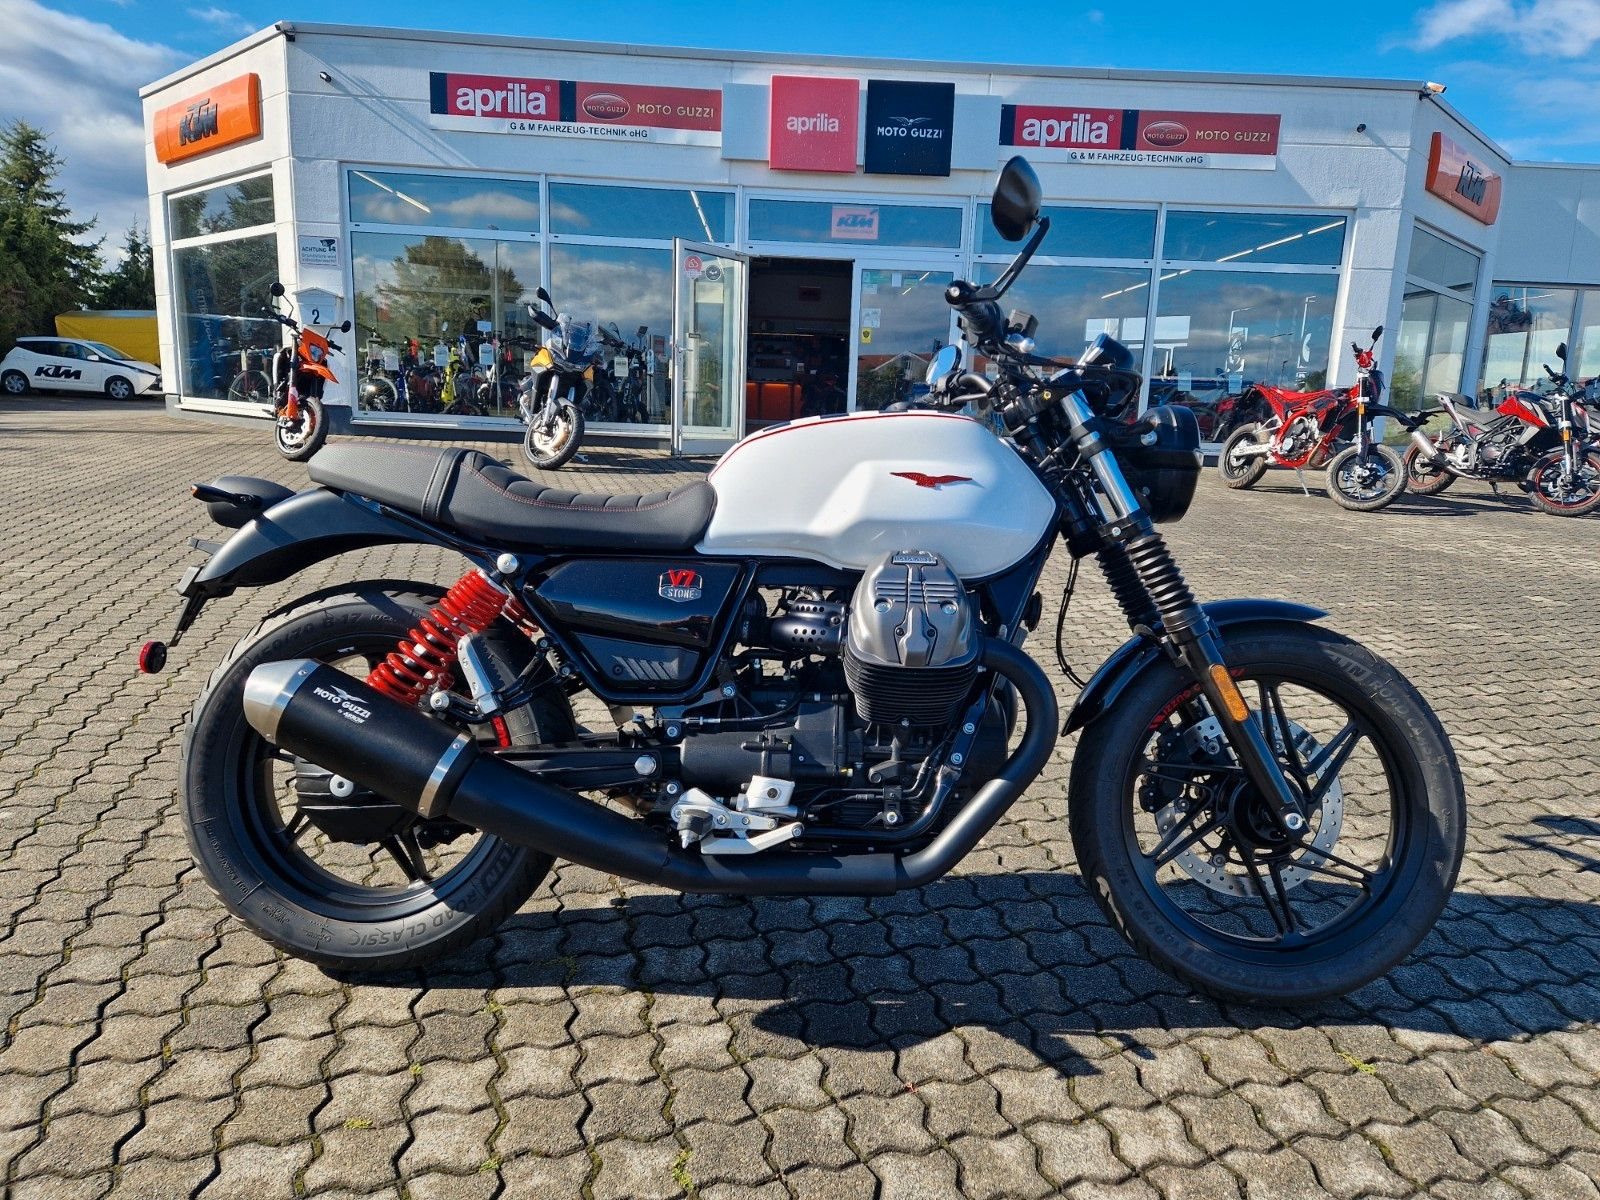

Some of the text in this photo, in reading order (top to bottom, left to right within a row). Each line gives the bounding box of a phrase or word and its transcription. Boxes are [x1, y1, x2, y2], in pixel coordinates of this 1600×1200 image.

[456, 83, 546, 117] aprilia
[636, 104, 714, 118] MOTO GUZZI
[179, 98, 218, 146] KTM
[510, 122, 517, 130] G
[528, 123, 536, 131] M
[538, 124, 630, 137] FAHRZEUG-TECHNIK
[786, 112, 839, 134] aprilia
[1022, 113, 1108, 147] aprilia
[876, 126, 942, 139] MOTO GUZZI
[1195, 130, 1270, 142] MOTO GUZZI
[1070, 152, 1078, 160] G
[1079, 152, 1086, 160] &
[1088, 152, 1095, 160] M
[1097, 152, 1184, 163] FAHRZEUG-TECHNIK
[836, 214, 874, 228] KTM
[311, 308, 320, 324] 2
[34, 364, 82, 380] KTM
[668, 569, 696, 587] V7
[668, 588, 694, 598] STONE
[313, 687, 372, 718] MOTO GUZZI
[432, 890, 478, 926] ROAD
[348, 922, 427, 946] CLASSIC
